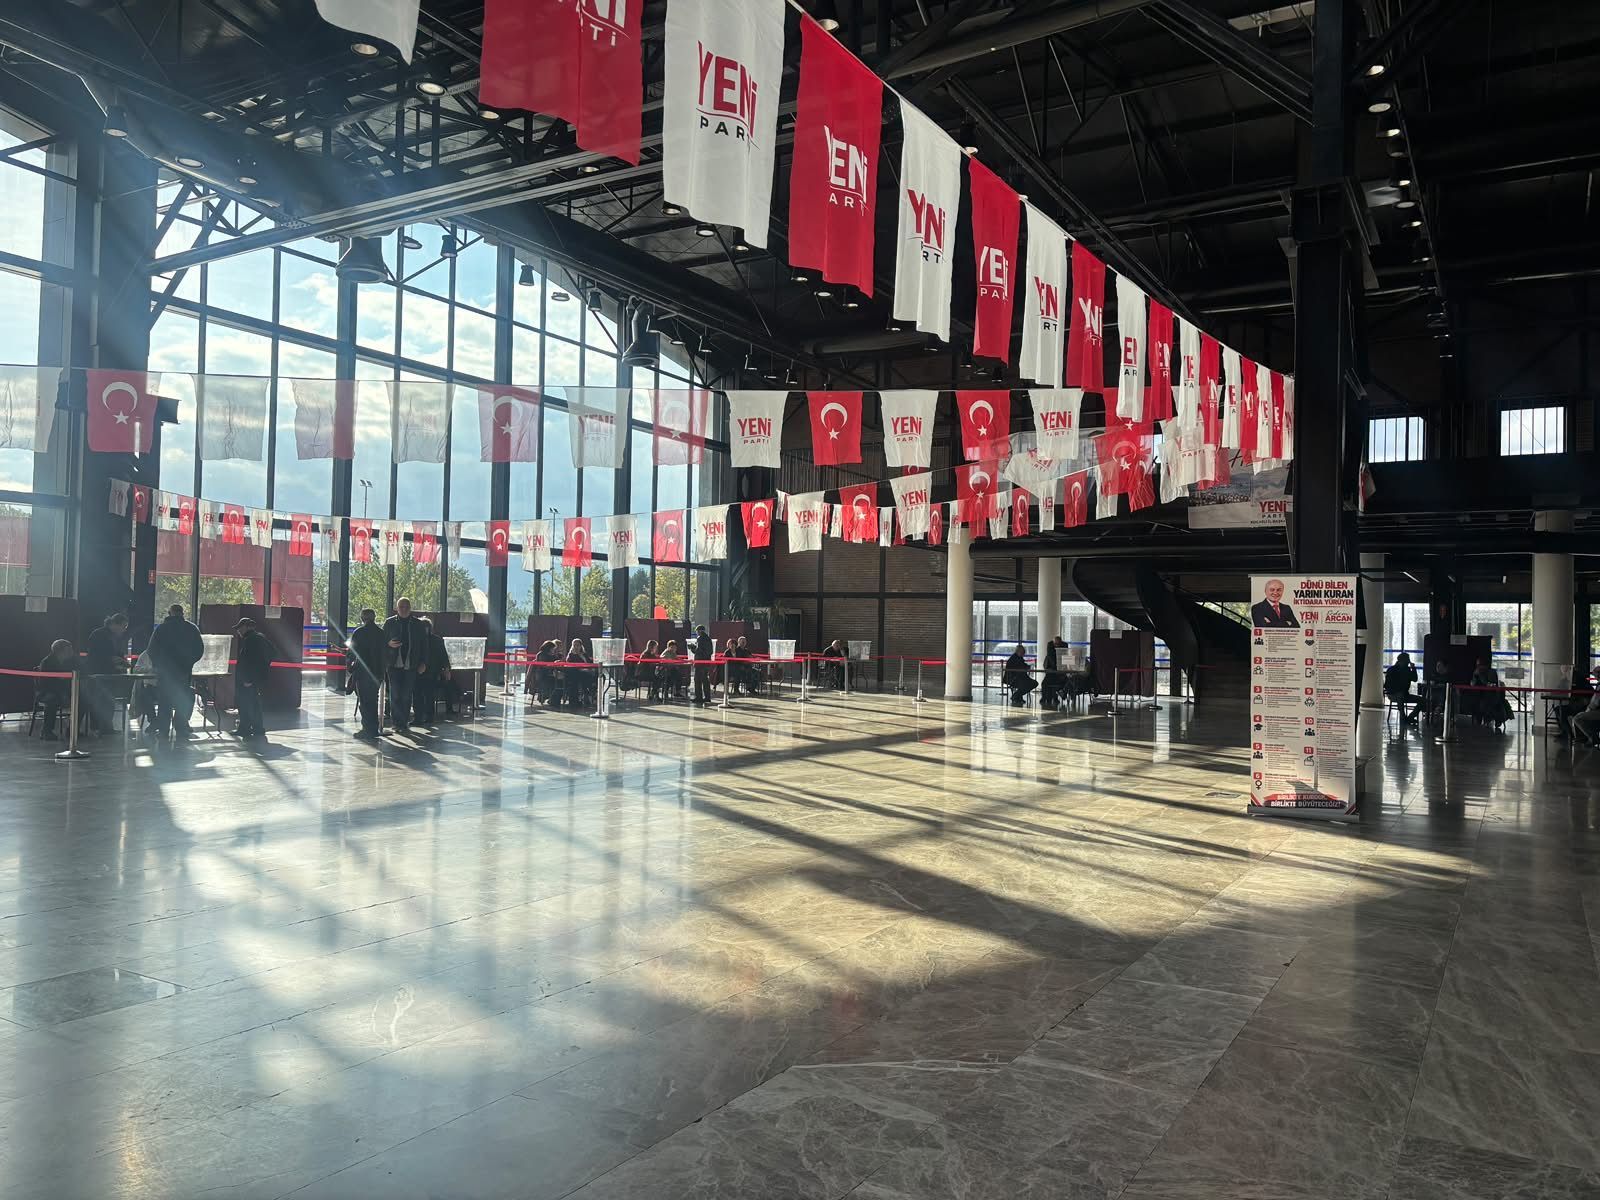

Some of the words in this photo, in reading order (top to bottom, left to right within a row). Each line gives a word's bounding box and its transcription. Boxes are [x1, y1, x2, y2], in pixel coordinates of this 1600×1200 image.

[1301, 579, 1324, 589] DÜNÜ
[1325, 579, 1348, 589] BİLEN
[1323, 589, 1354, 598] KURAN
